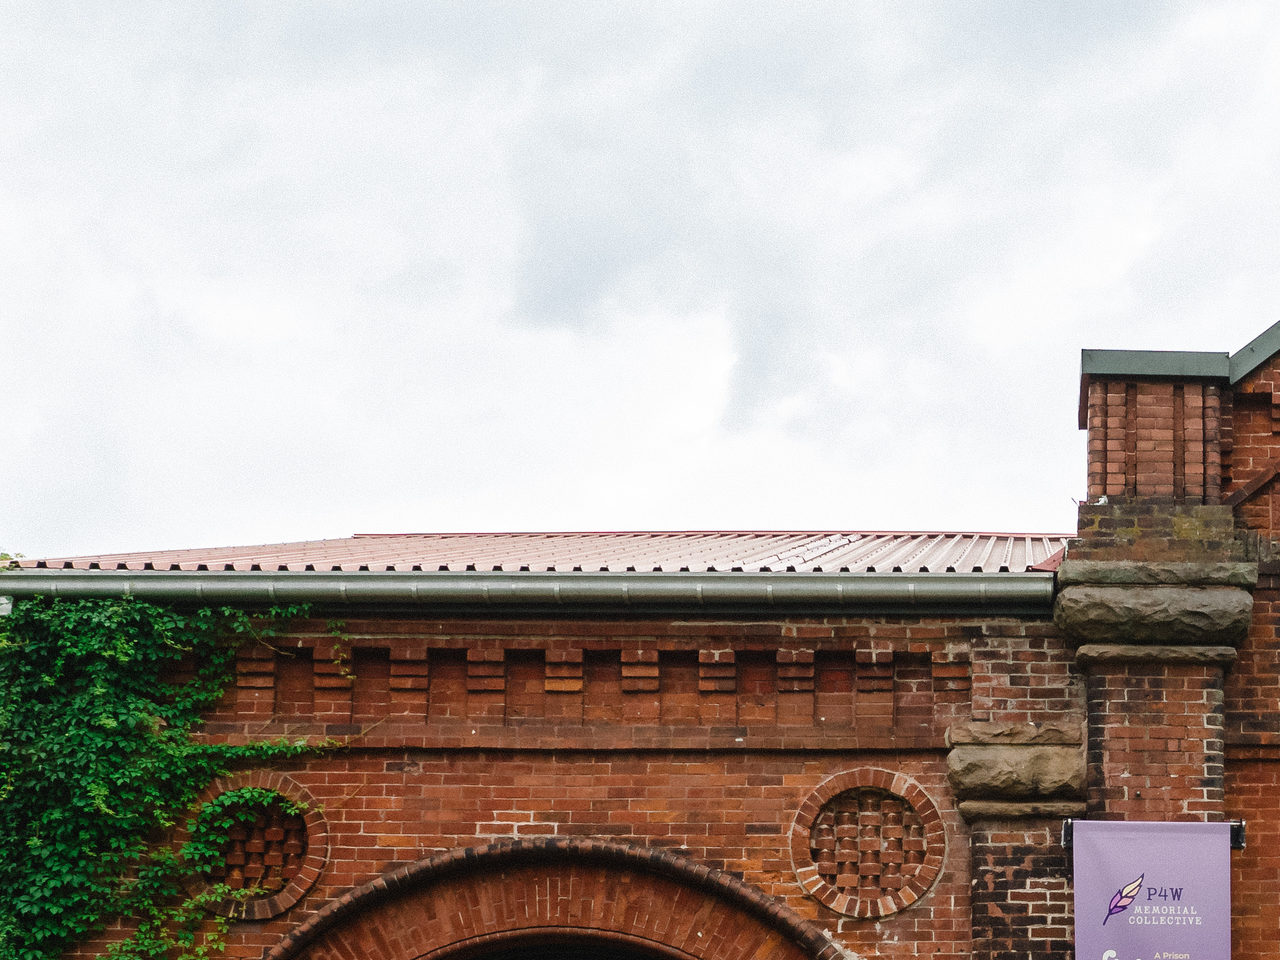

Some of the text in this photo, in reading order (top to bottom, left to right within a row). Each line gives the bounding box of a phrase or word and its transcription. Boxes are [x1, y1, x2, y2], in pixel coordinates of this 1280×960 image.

[1146, 886, 1184, 901] P4W
[1134, 906, 1197, 915] MEMORIAL
[1128, 916, 1202, 925] COLLECTIVE
[1153, 951, 1190, 960] A Prison
